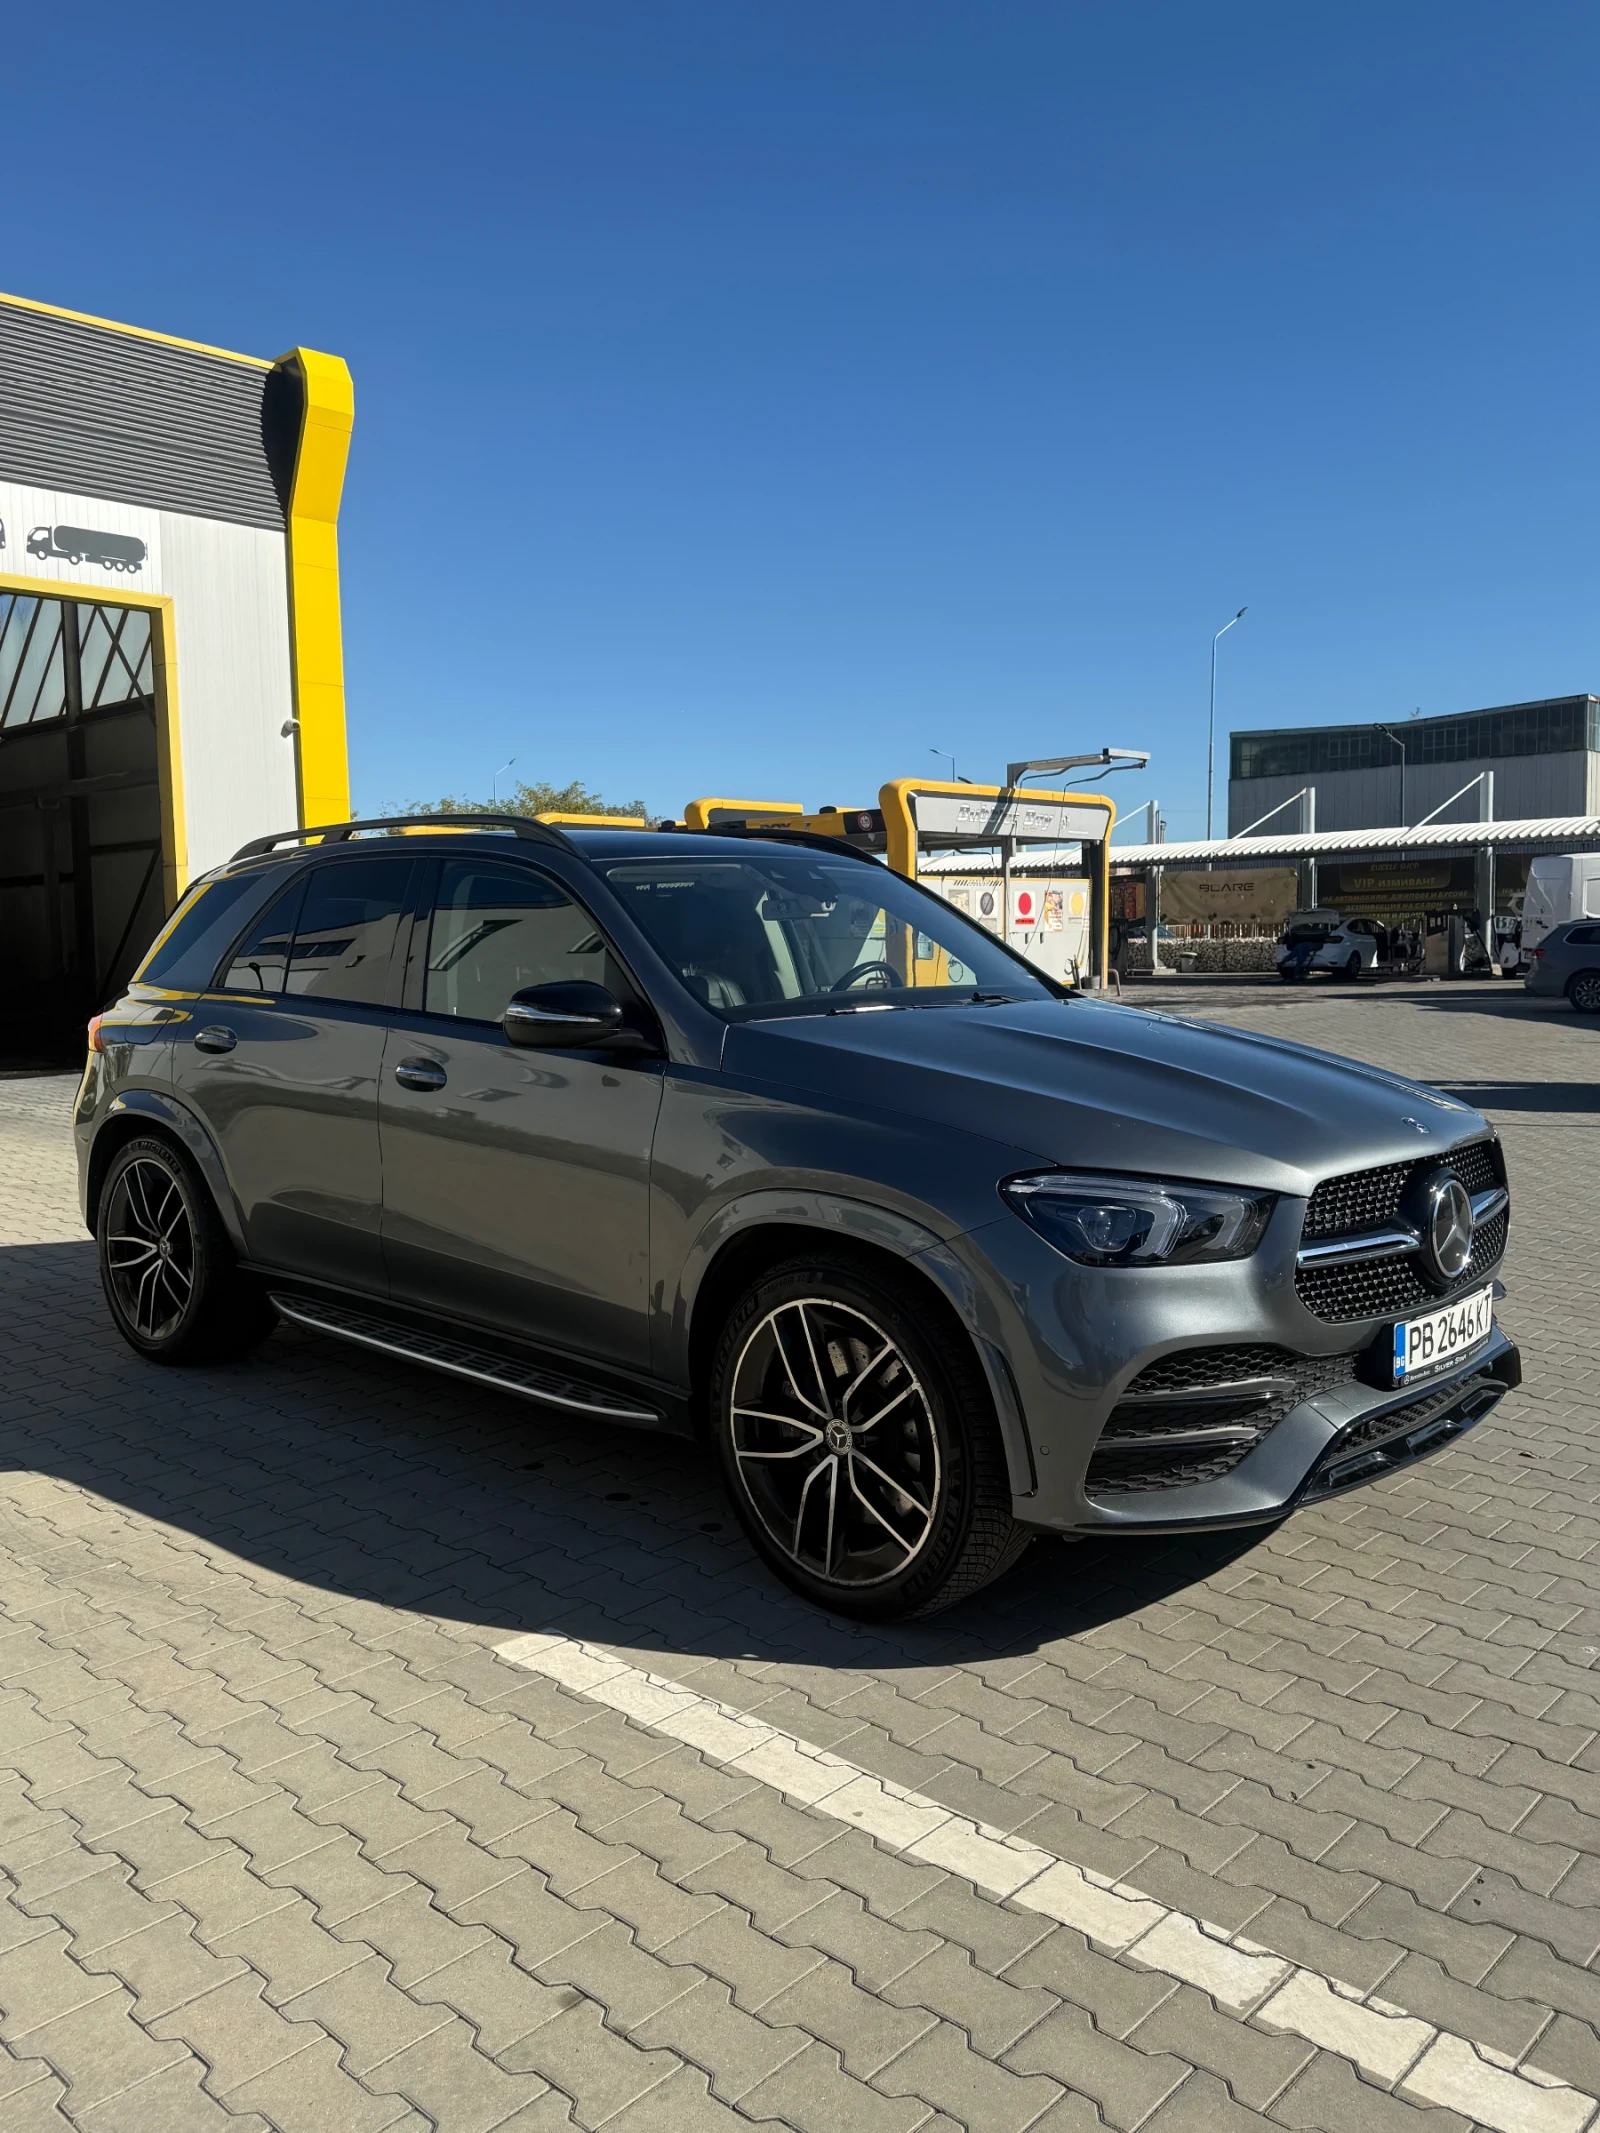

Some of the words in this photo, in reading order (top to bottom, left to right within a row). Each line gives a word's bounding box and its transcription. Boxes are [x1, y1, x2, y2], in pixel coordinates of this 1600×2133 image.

[1354, 878, 1375, 888] VIP
[1378, 877, 1436, 887] ИЗМИВАНЕ
[141, 1141, 179, 1172] MICHELIN
[1409, 1322, 1433, 1364] PB
[1437, 1303, 1475, 1354] 2646
[1476, 1292, 1491, 1336] KT
[1396, 1356, 1405, 1369] BG
[903, 1495, 960, 1597] MICHELIN
